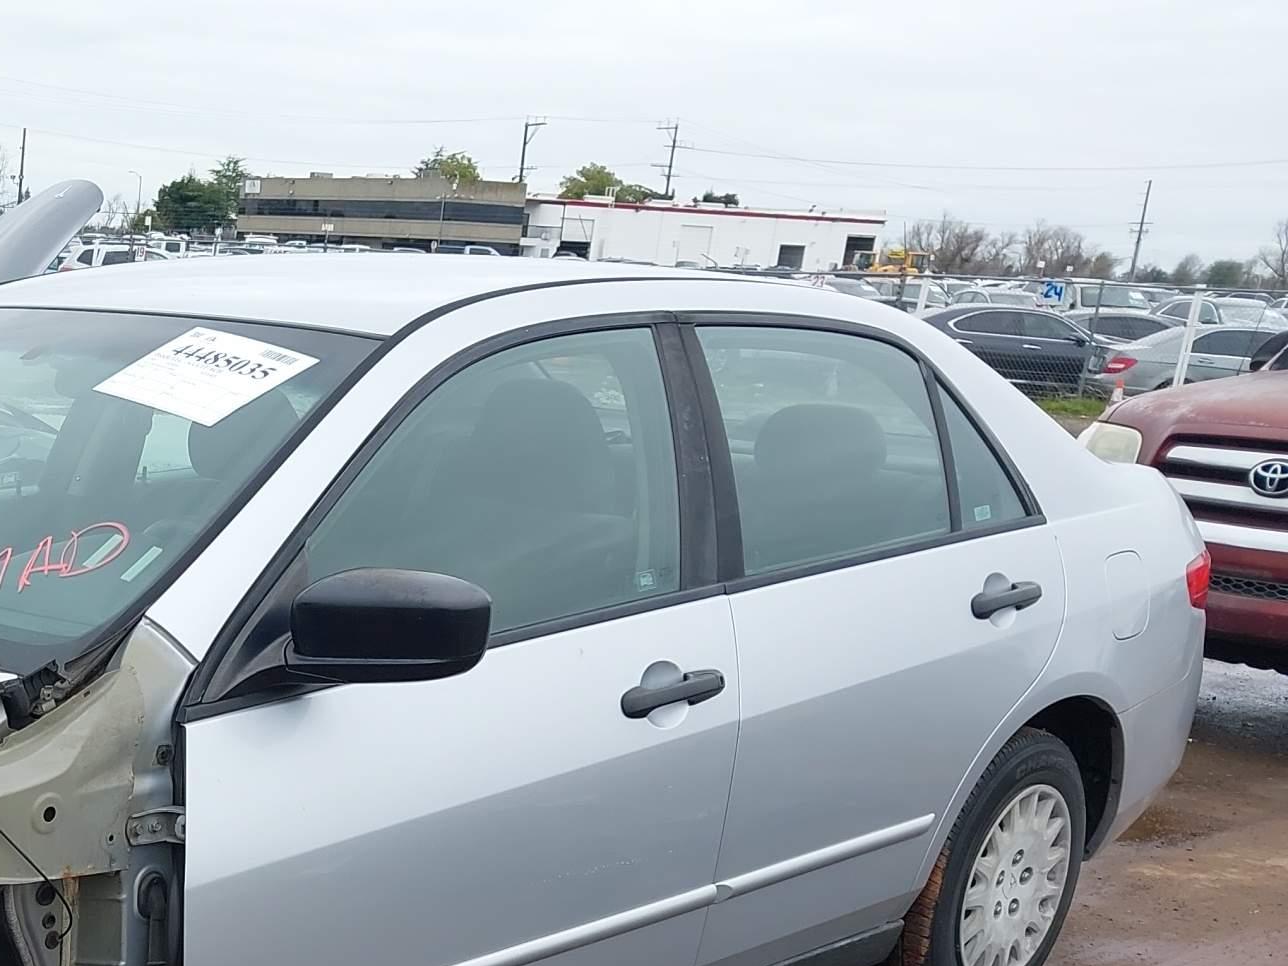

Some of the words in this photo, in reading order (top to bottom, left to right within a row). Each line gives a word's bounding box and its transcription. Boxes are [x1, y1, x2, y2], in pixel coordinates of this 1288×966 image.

[137, 247, 145, 257] 19
[1043, 281, 1063, 302] 24
[172, 344, 278, 379] 44485035
